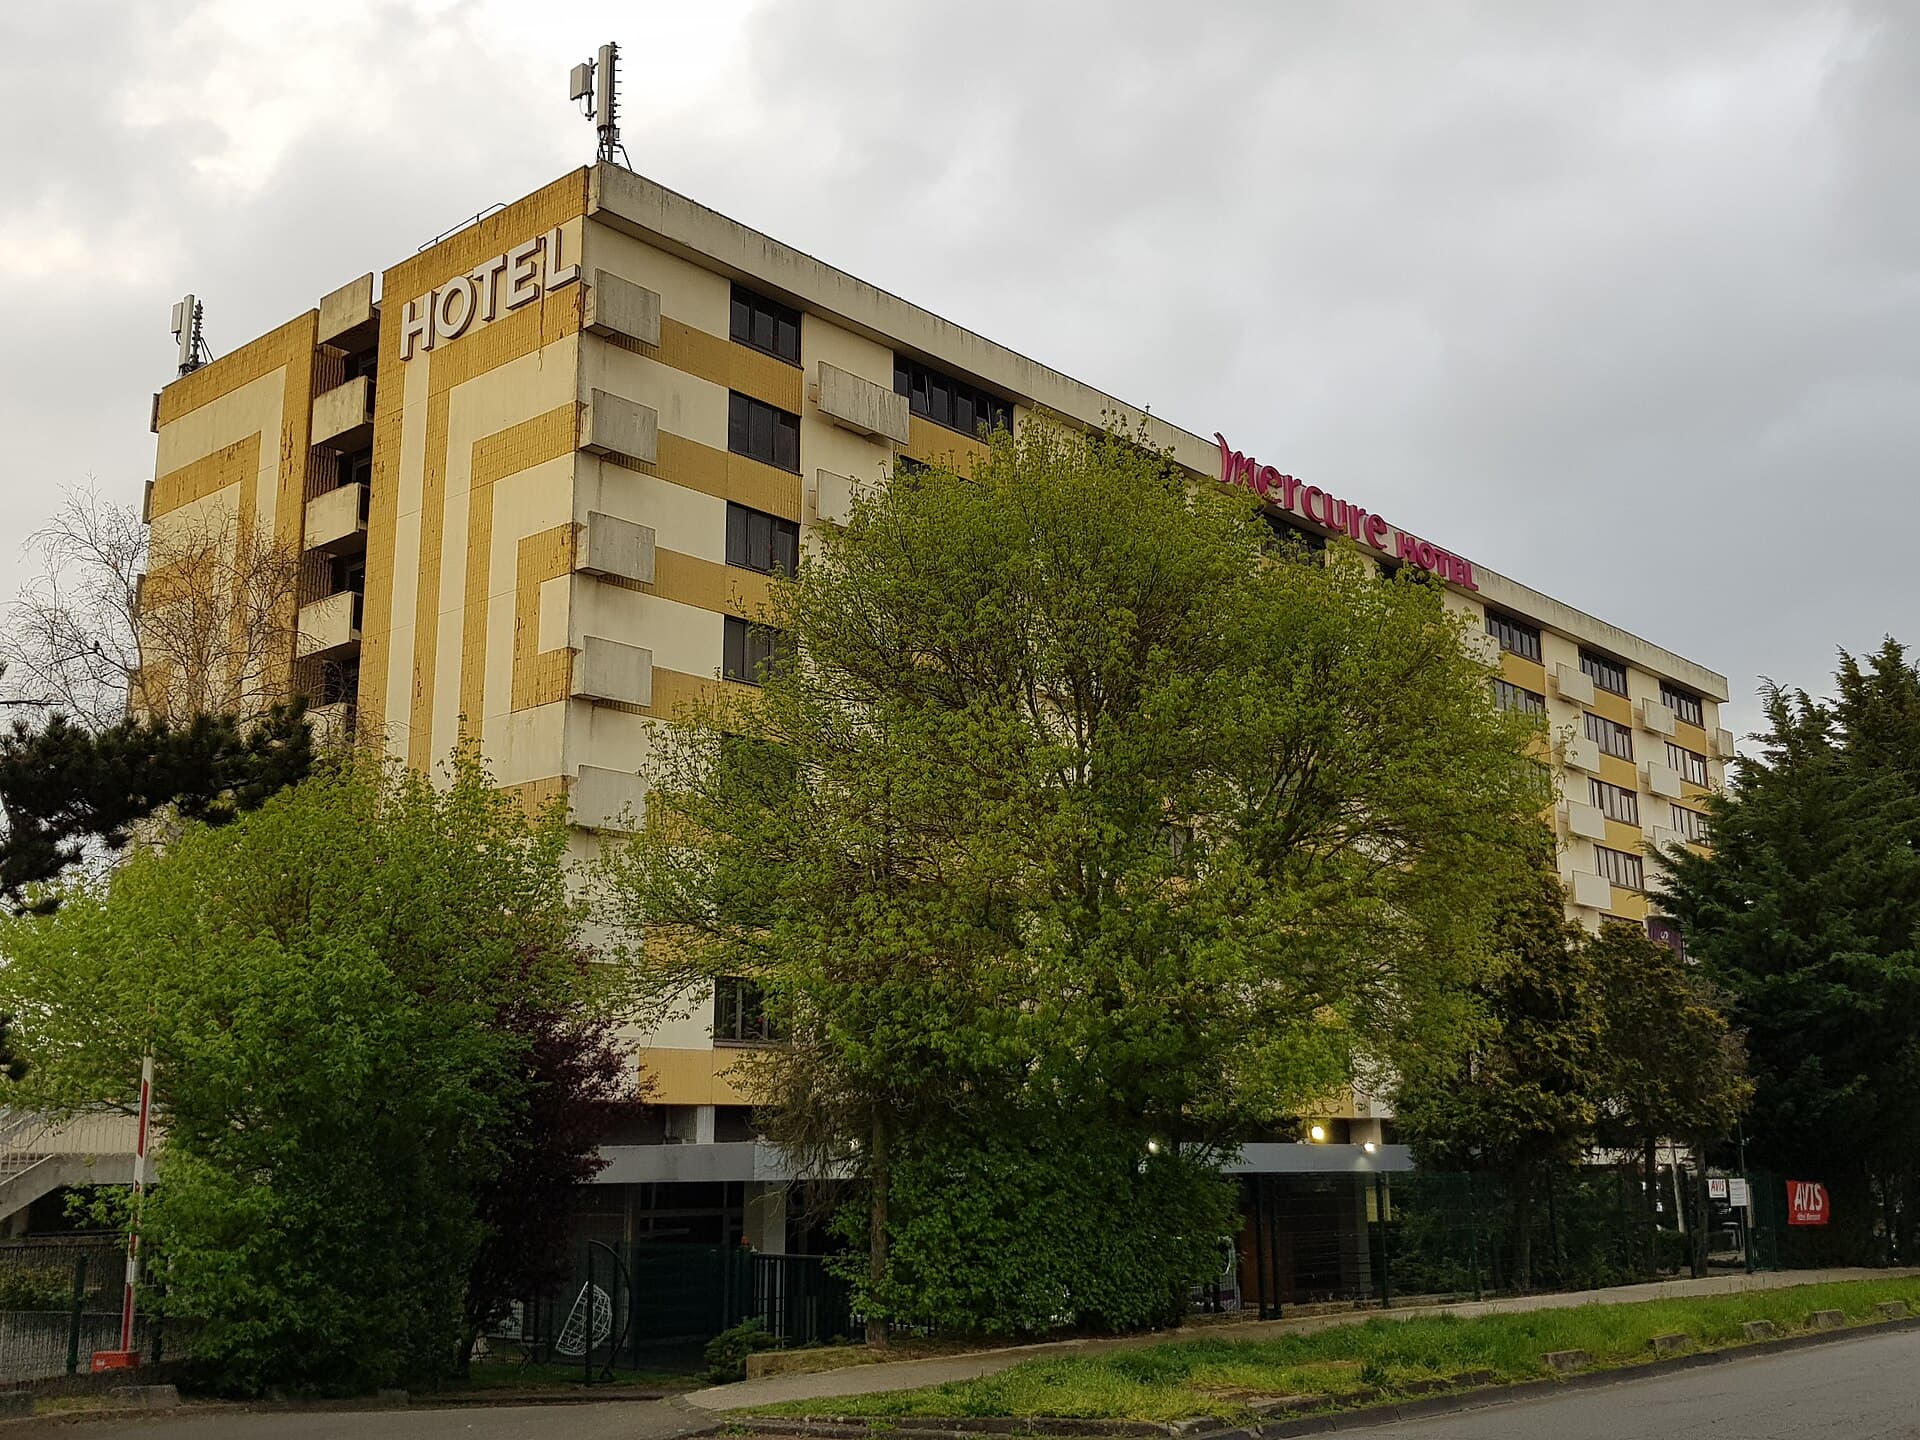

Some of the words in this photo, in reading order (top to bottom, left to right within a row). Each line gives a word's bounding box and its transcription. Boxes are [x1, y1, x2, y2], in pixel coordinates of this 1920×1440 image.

[400, 226, 582, 362] HOTEL
[1395, 530, 1480, 592] HOTEL
[1711, 1179, 1725, 1192] AVIS
[1794, 1183, 1823, 1212] AVIS
